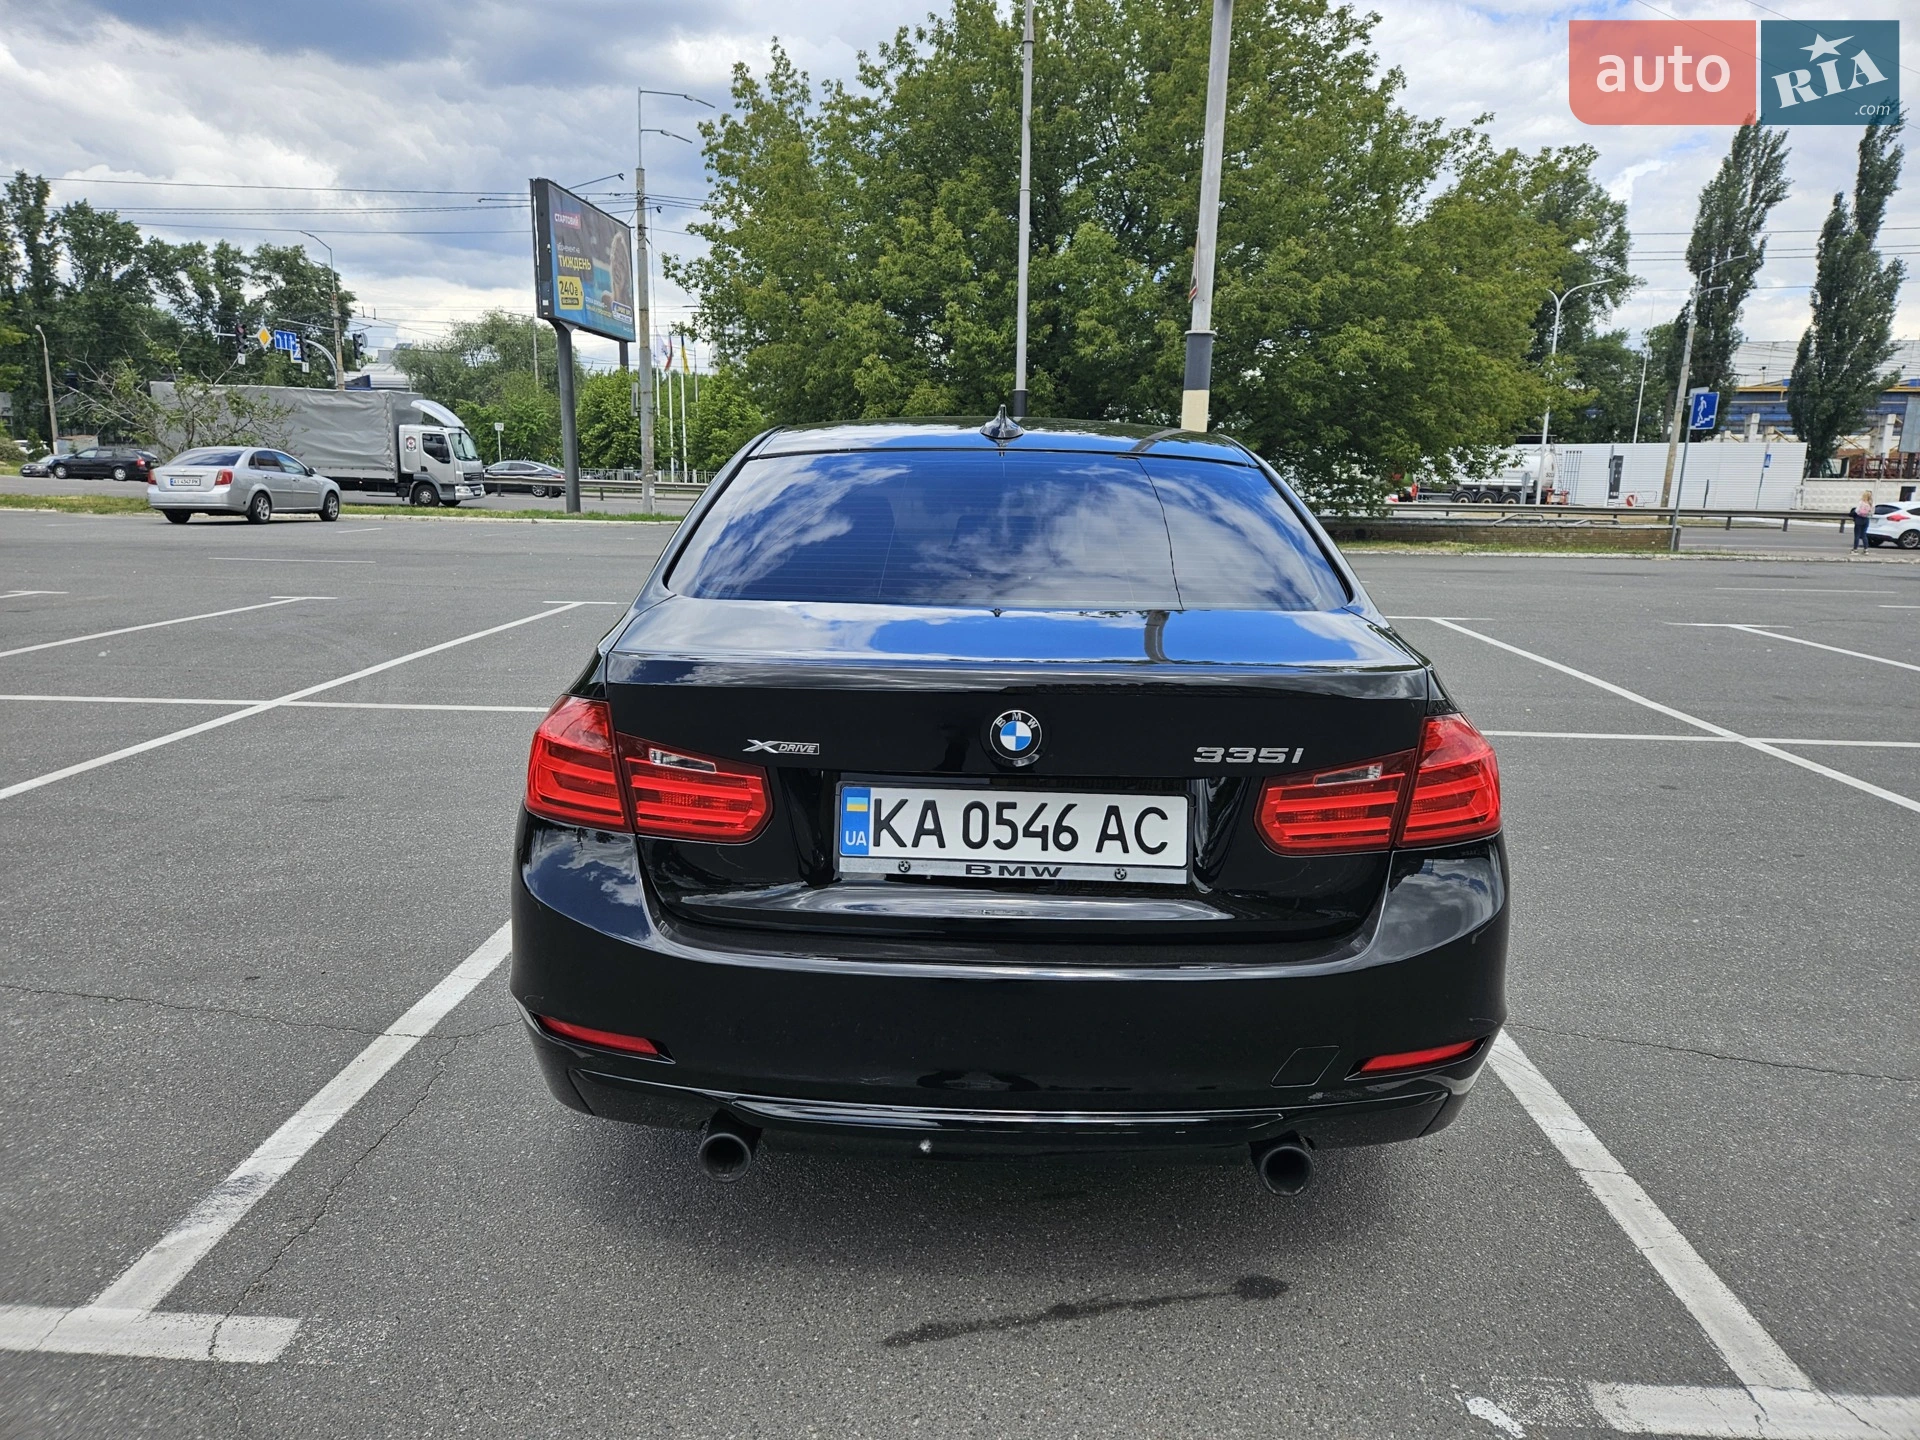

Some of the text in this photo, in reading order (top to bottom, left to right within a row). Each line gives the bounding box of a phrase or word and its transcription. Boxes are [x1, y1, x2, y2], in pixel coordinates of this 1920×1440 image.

[558, 255, 591, 271] ТИЖДЕНЬ
[995, 712, 1038, 729] BMW
[873, 798, 1168, 855] KA 0546 AC
[845, 830, 867, 846] UA
[965, 864, 1062, 878] BMW
